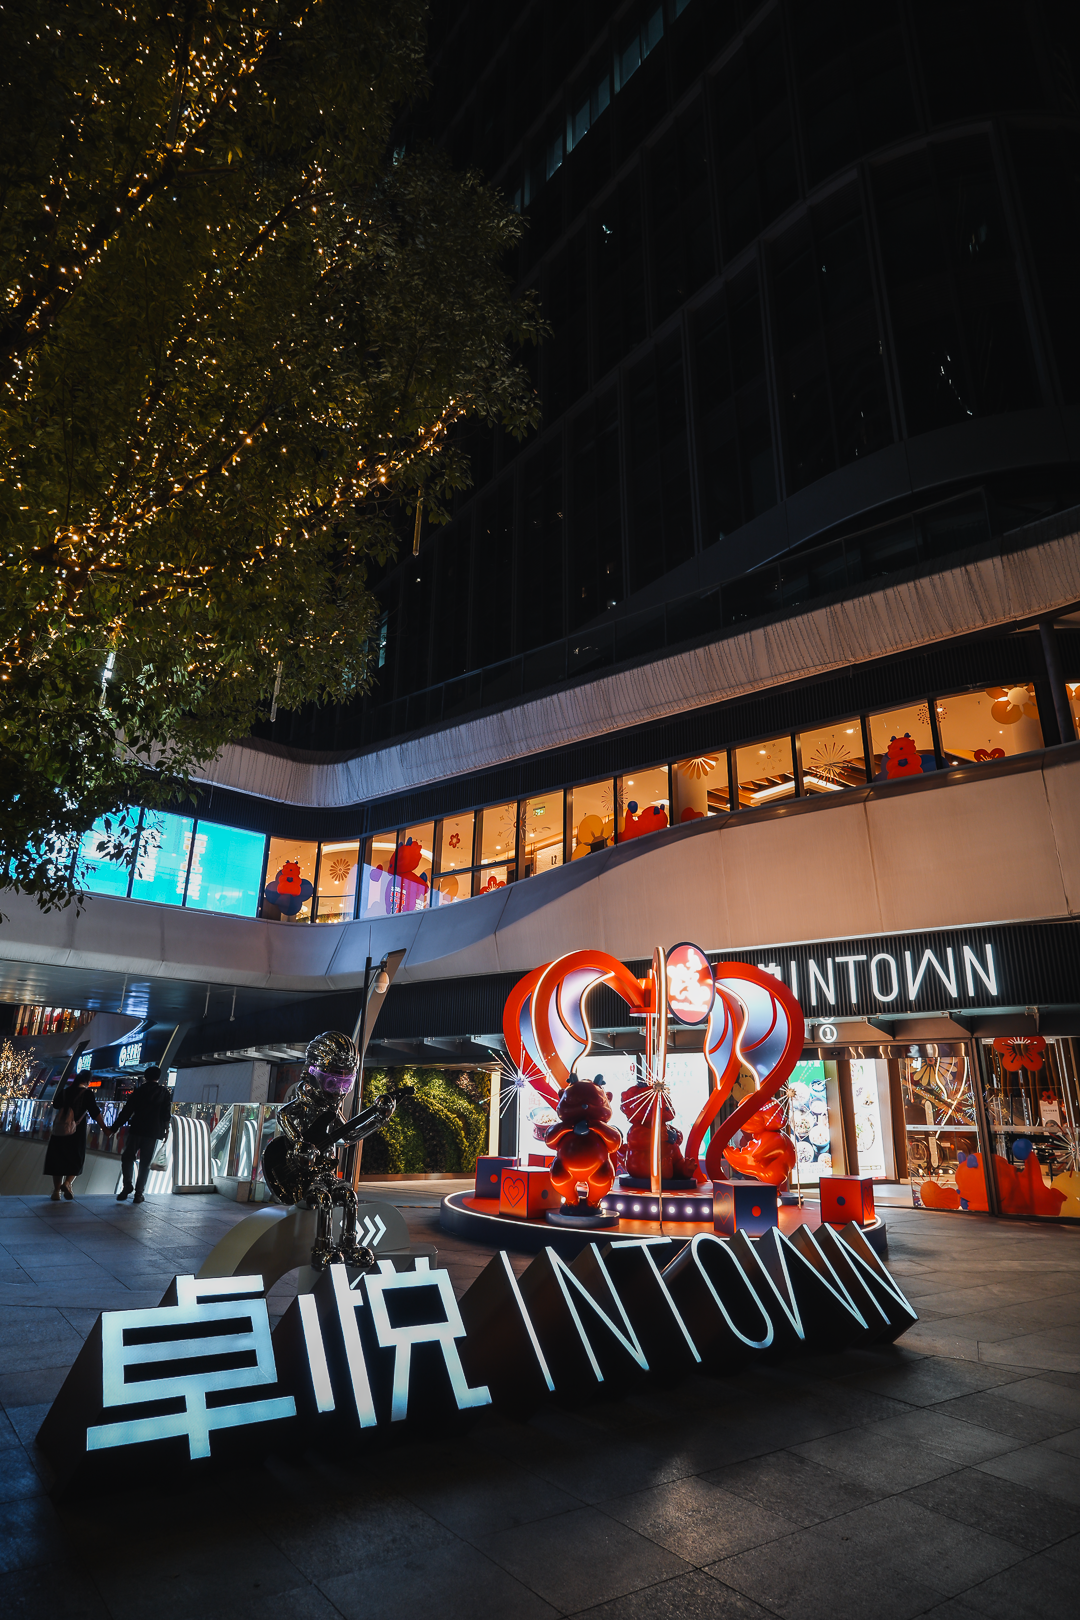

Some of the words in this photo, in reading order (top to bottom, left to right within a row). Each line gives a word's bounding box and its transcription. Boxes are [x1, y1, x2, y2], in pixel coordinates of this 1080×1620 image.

[790, 943, 998, 1006] INTOWN
[86, 1258, 492, 1460] 卓悦
[500, 1220, 918, 1392] INTOWN
